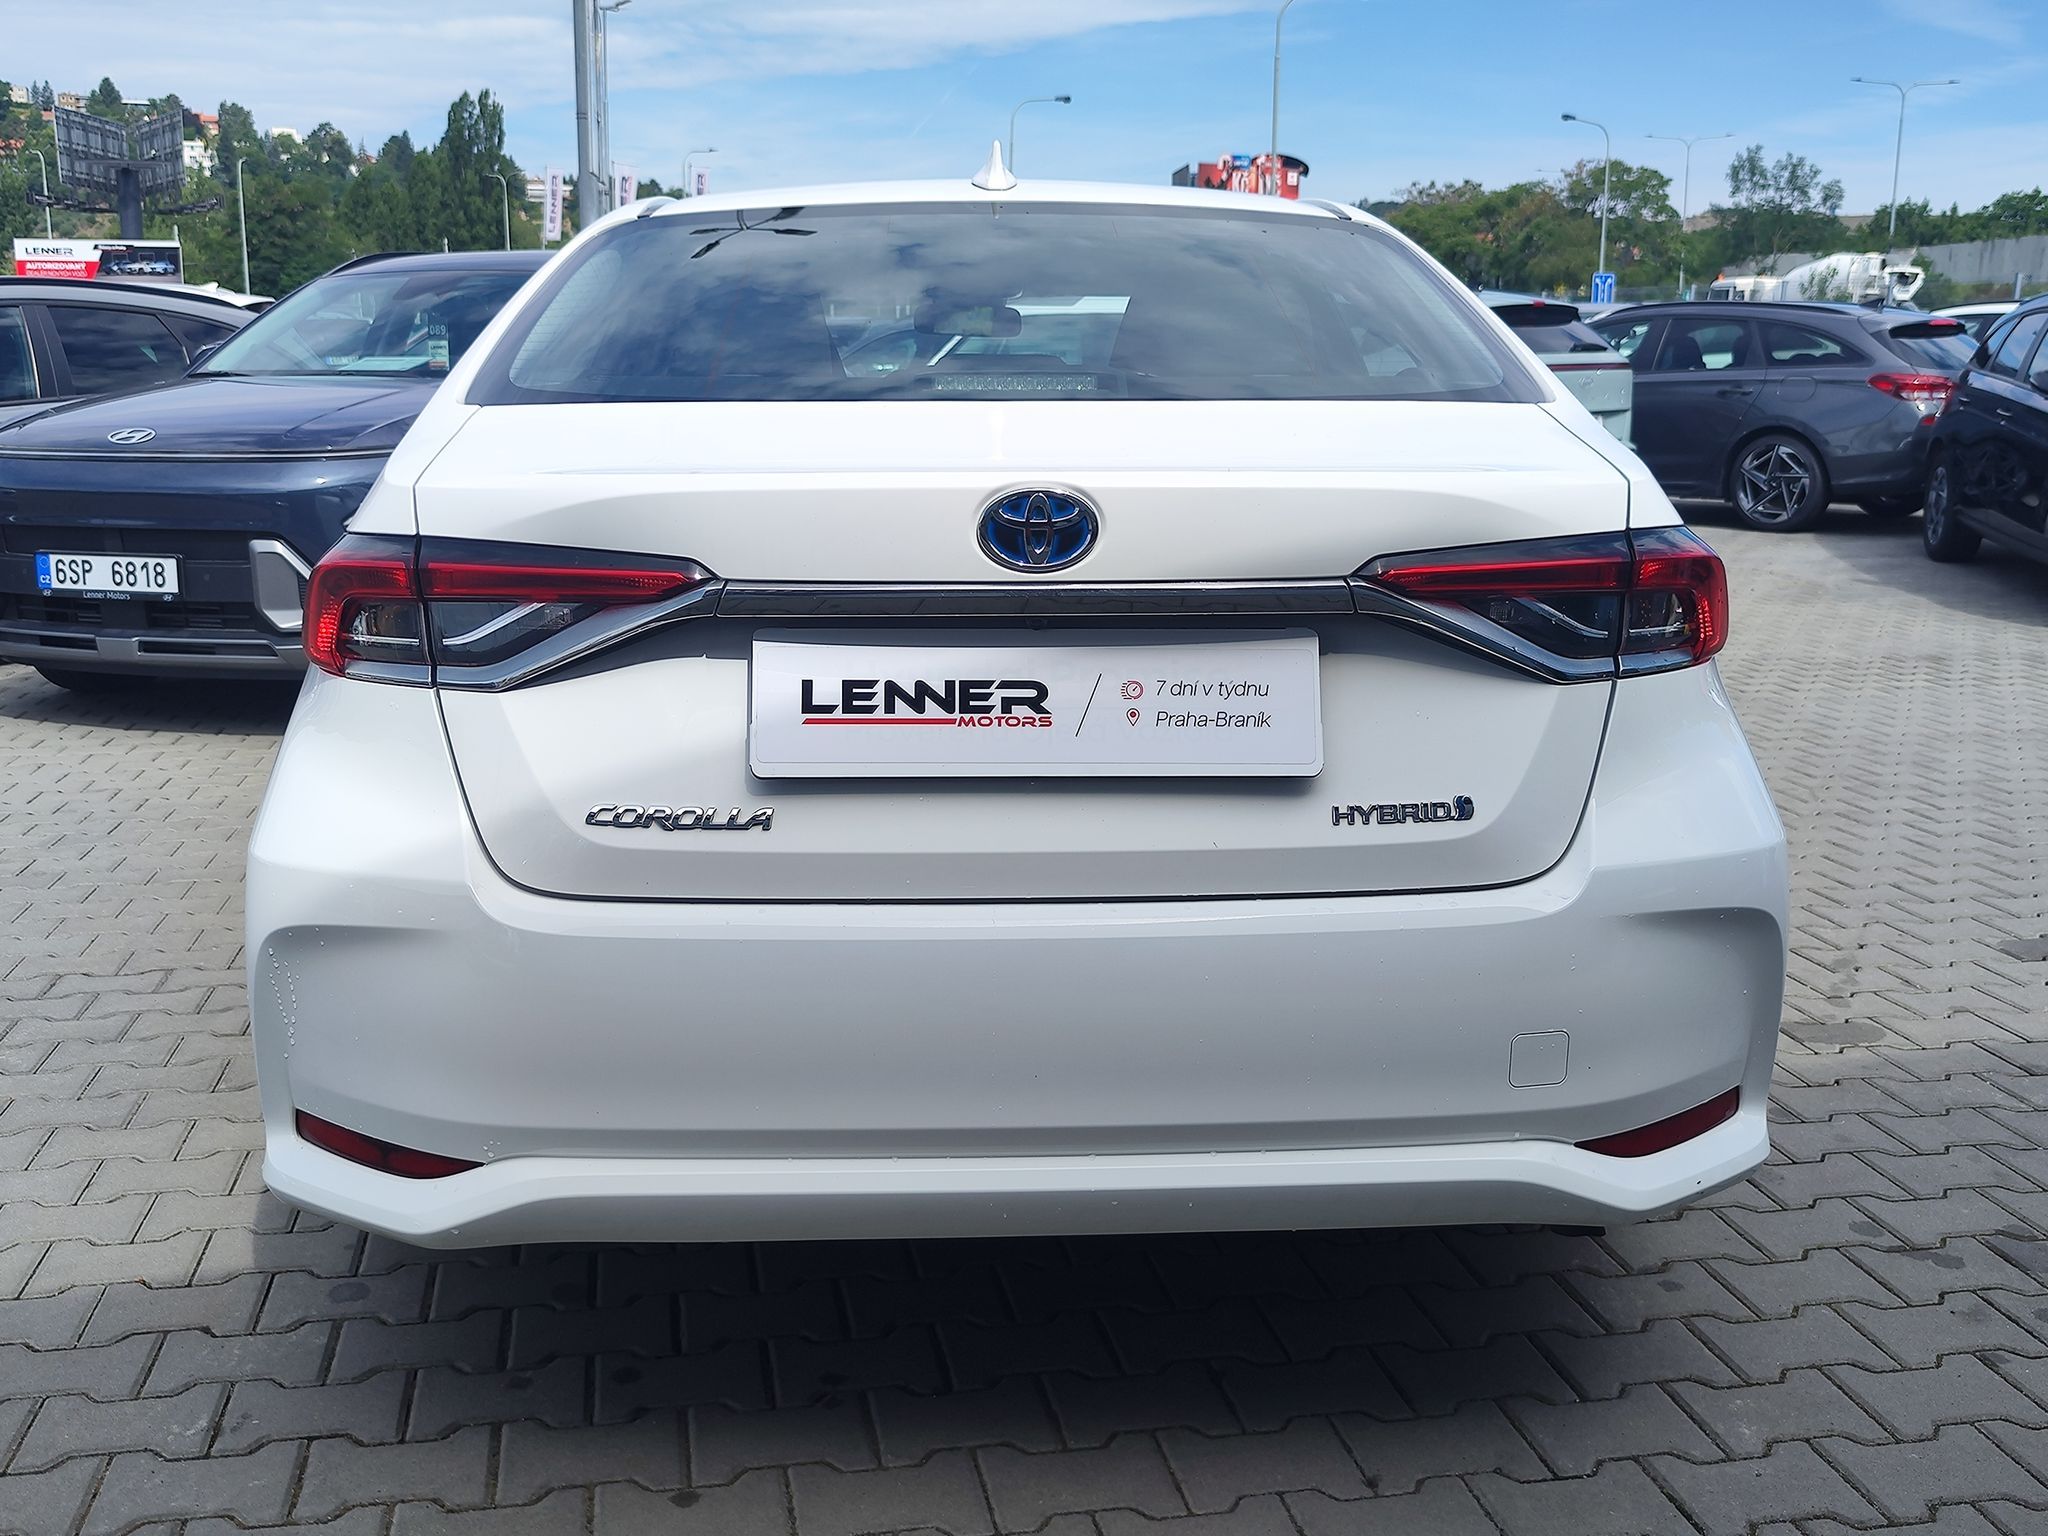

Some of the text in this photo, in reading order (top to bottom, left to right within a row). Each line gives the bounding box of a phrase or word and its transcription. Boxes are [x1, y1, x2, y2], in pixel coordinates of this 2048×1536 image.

[548, 175, 559, 233] LENNER
[25, 247, 74, 255] LENNER
[40, 575, 51, 584] CZ
[55, 558, 166, 588] 6SP 6818
[83, 590, 131, 601] Lenner Motors
[801, 679, 1053, 715] LENNER
[1155, 679, 1270, 701] 7 dní v týdnu
[956, 715, 1054, 728] MOTORS
[1155, 711, 1272, 728] Praha-Braník
[584, 803, 775, 832] COROLLA
[1331, 801, 1452, 826] HYBRID
